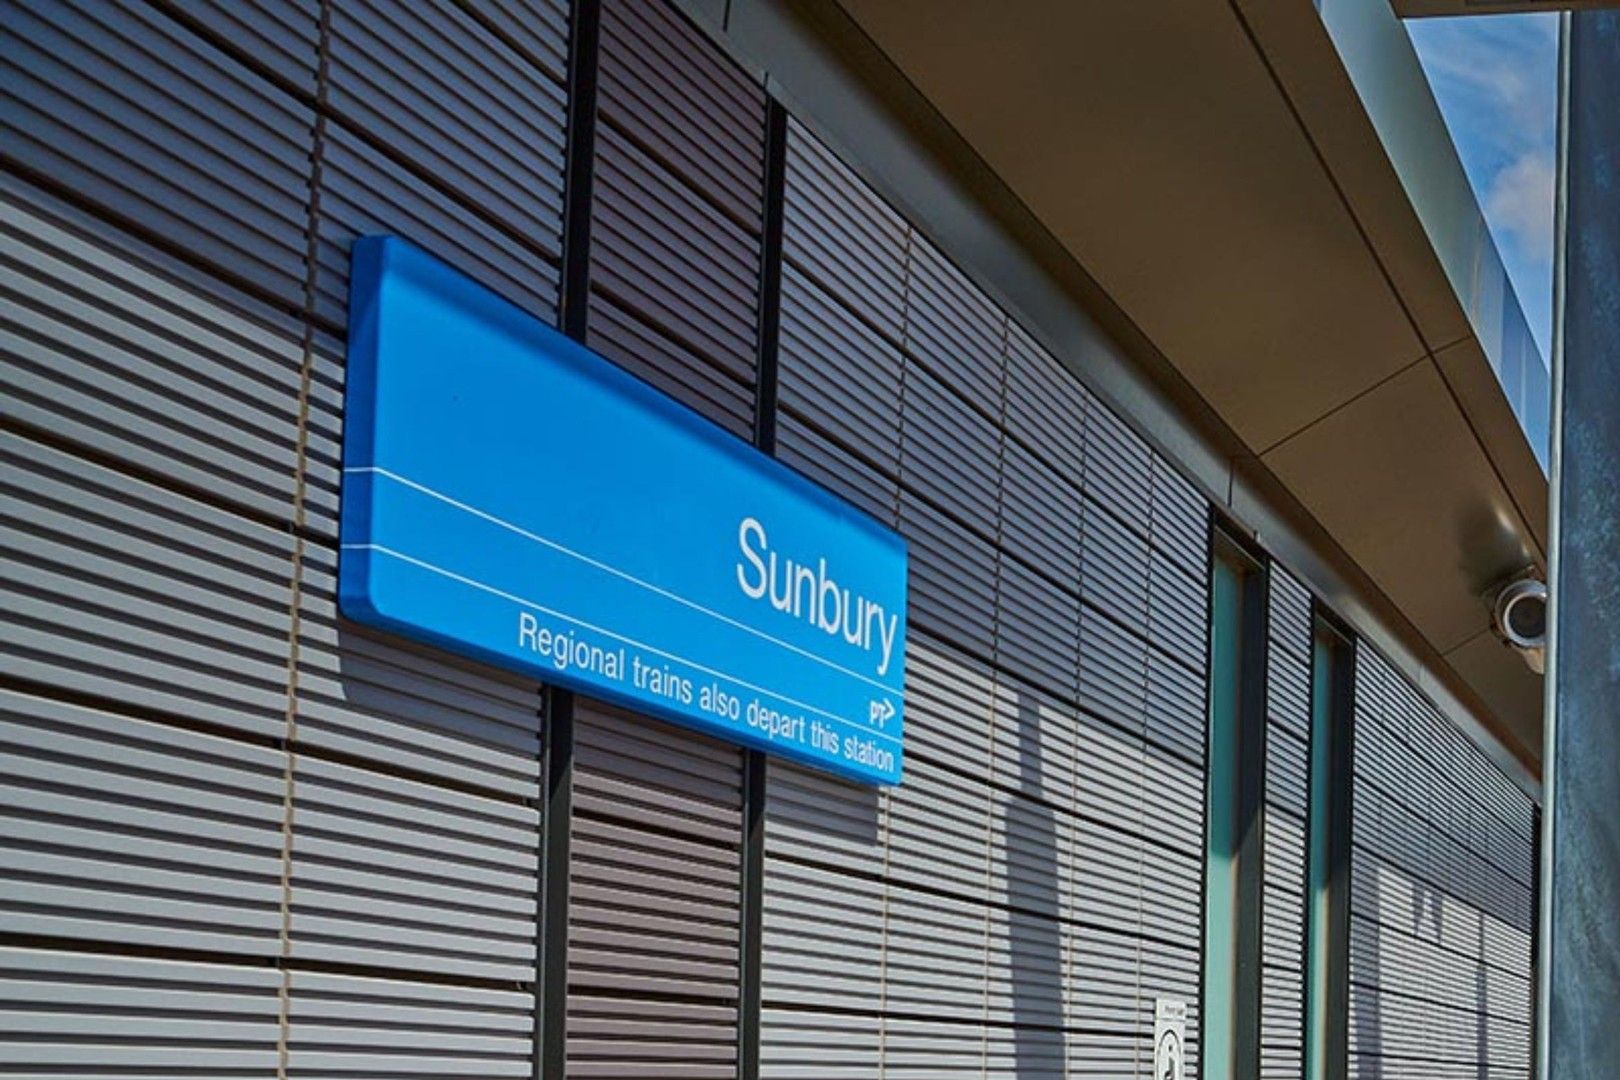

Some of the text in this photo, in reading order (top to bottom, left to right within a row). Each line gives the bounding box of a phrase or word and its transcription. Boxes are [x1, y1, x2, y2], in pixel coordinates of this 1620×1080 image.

[737, 518, 897, 674] Sunbury
[519, 612, 894, 774] Regional trains also depart this station
